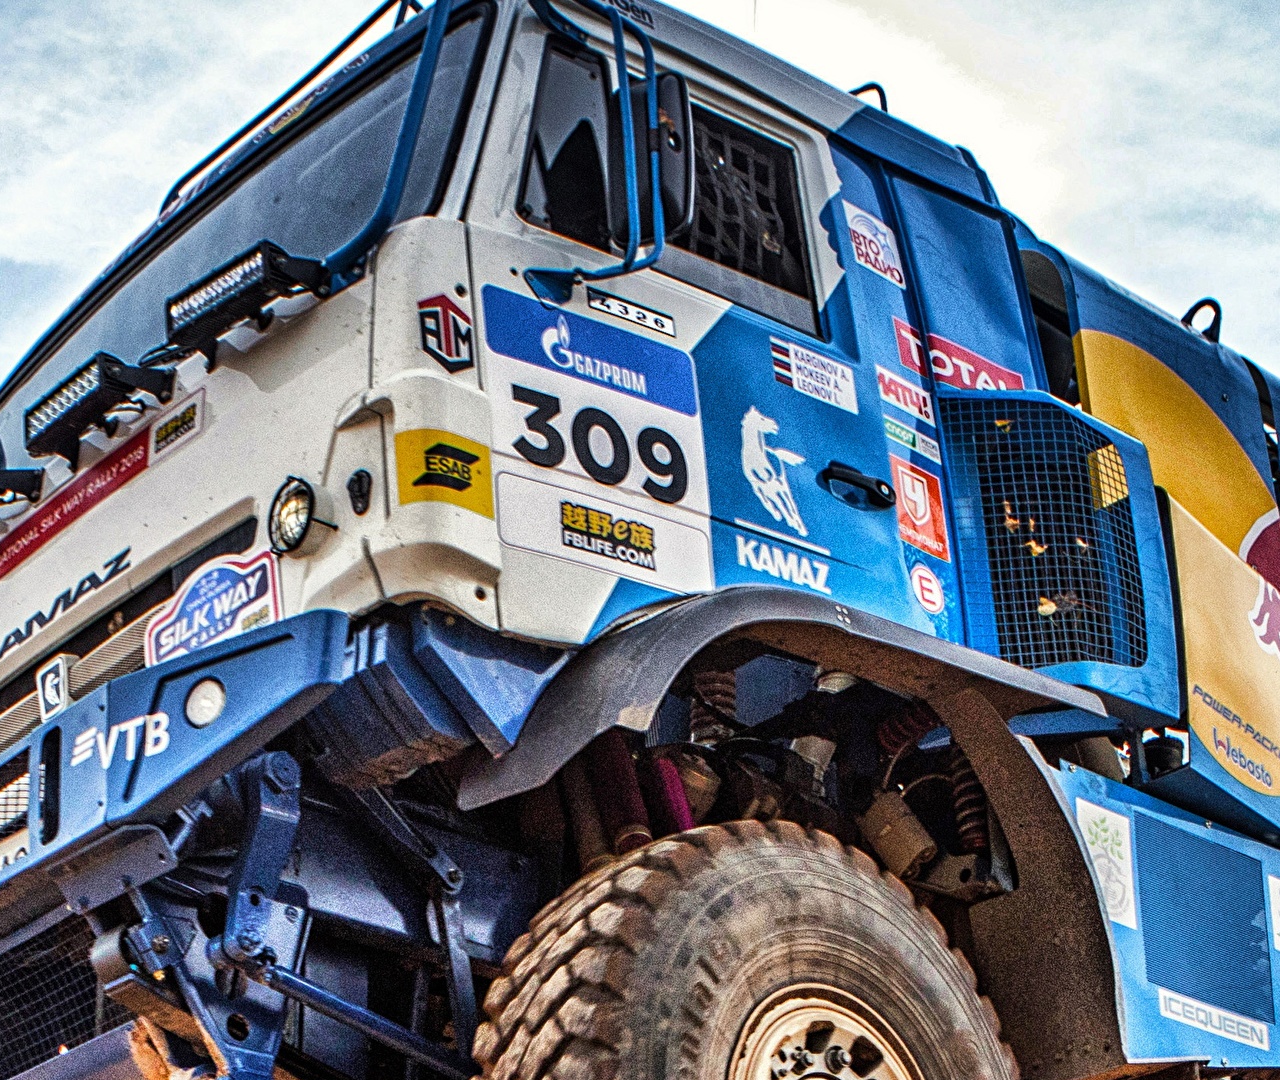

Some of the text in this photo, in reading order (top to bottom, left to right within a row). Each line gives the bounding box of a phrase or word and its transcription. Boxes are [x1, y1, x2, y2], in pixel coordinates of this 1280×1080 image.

[856, 245, 903, 284] РАДИО
[598, 296, 665, 329] 4326
[574, 353, 647, 395] GAZPROM
[793, 348, 838, 376] KARGINOV
[795, 363, 831, 387] MOKEEV
[797, 377, 831, 400] LEONOV
[511, 383, 689, 504] 309
[424, 455, 473, 481] ESAB
[40, 508, 62, 533] SILK
[62, 490, 85, 514] WAY
[86, 463, 119, 497] RALLY
[120, 446, 144, 473] 2018
[563, 530, 655, 568] FBLIFE.COM
[736, 535, 832, 595] KAMAZ
[159, 603, 211, 655] SILK
[213, 570, 262, 619] WAY
[190, 615, 232, 648] RALLY
[96, 712, 170, 770] VTB
[1213, 727, 1272, 788] Webasto
[1163, 995, 1264, 1044] ICEQUEEN
